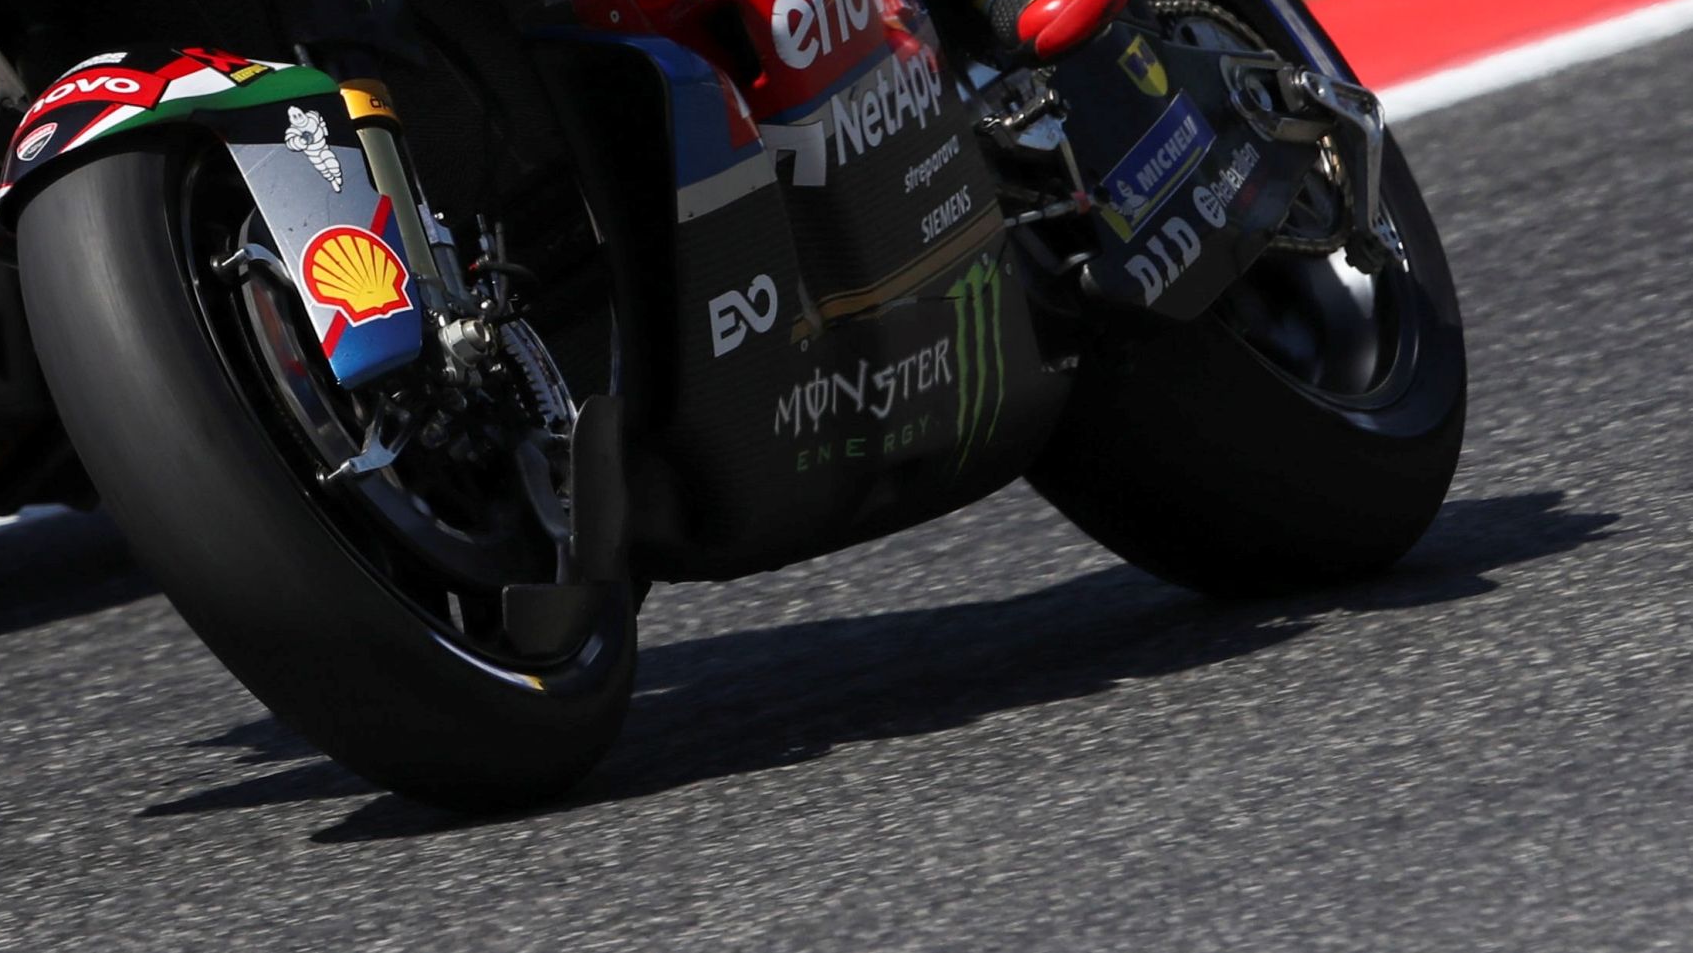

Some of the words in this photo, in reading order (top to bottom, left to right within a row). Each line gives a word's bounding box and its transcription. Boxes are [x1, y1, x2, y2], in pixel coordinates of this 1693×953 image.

[830, 48, 942, 167] NetApp
[1136, 115, 1198, 193] MICHELIN
[921, 185, 972, 243] SIEMENS
[774, 339, 953, 439] MONSTER
[796, 415, 930, 471] ENERGY
